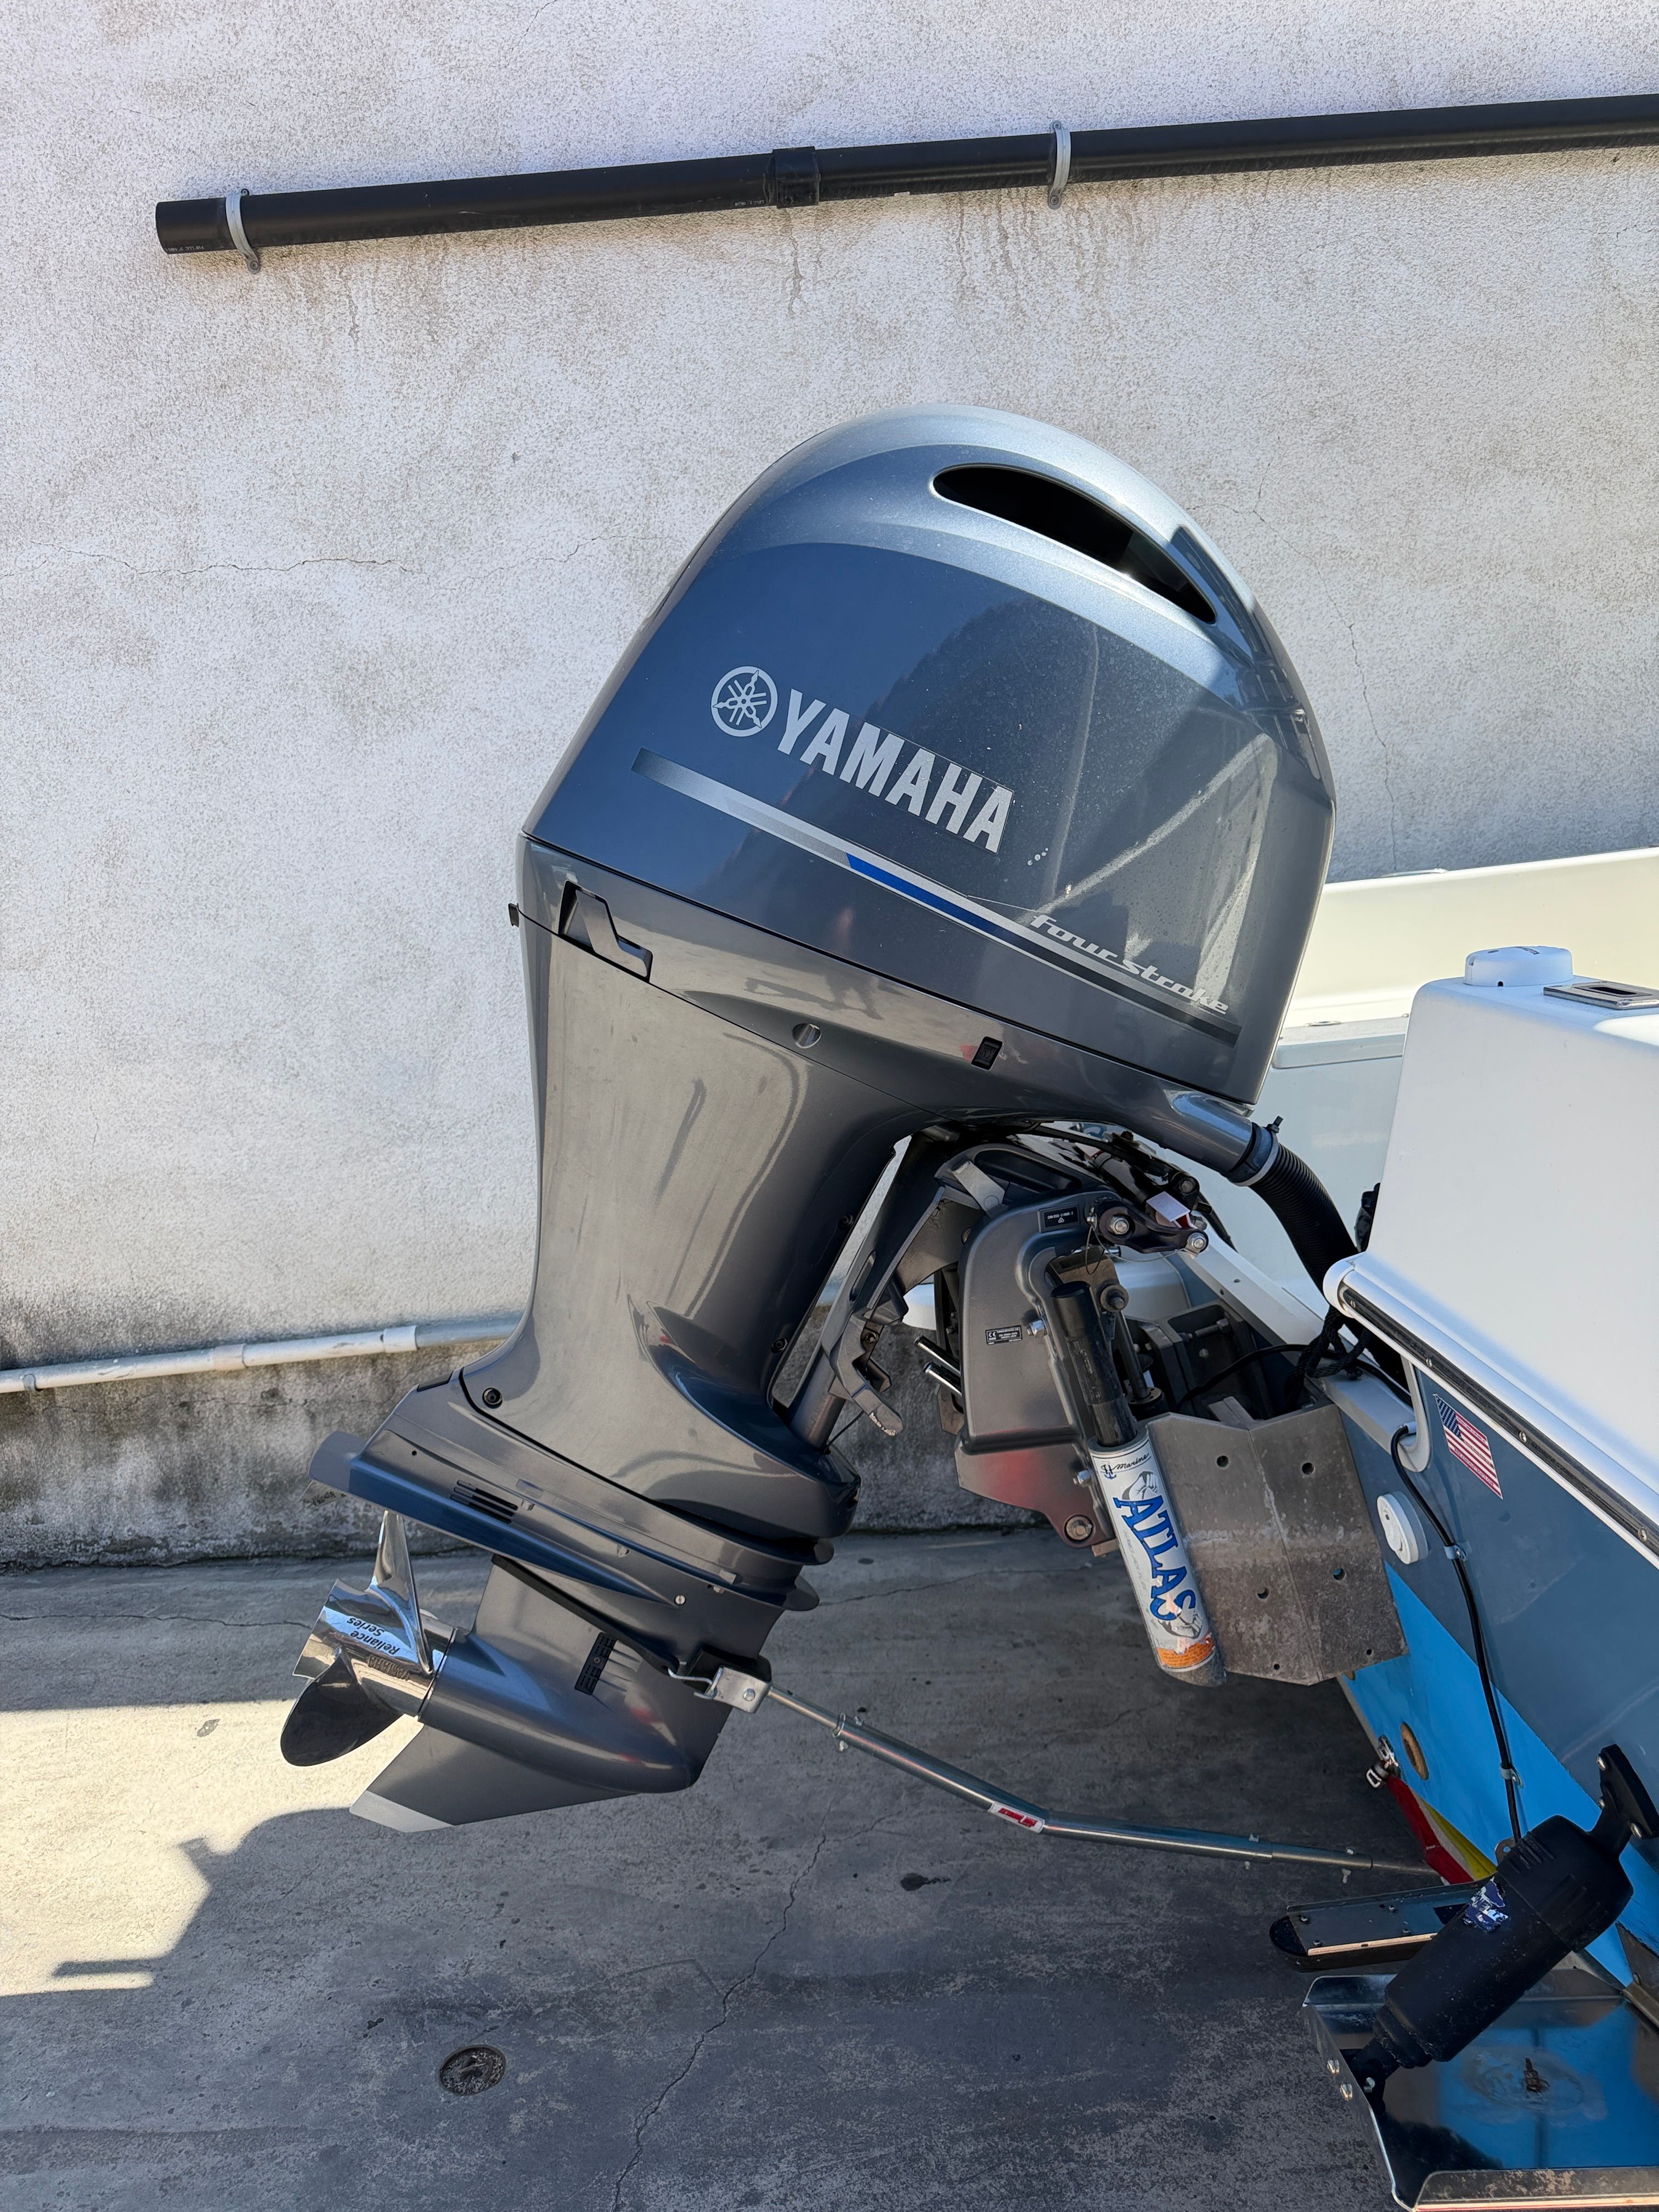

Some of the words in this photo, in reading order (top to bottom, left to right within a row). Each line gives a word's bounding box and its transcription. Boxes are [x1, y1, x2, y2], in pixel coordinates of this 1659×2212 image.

[777, 689, 1014, 853] YAMAHA
[1116, 1453, 1150, 1470] Marine
[1113, 1495, 1197, 1621] ATLAS
[347, 1617, 386, 1636] Series
[349, 1629, 400, 1656] Reliance
